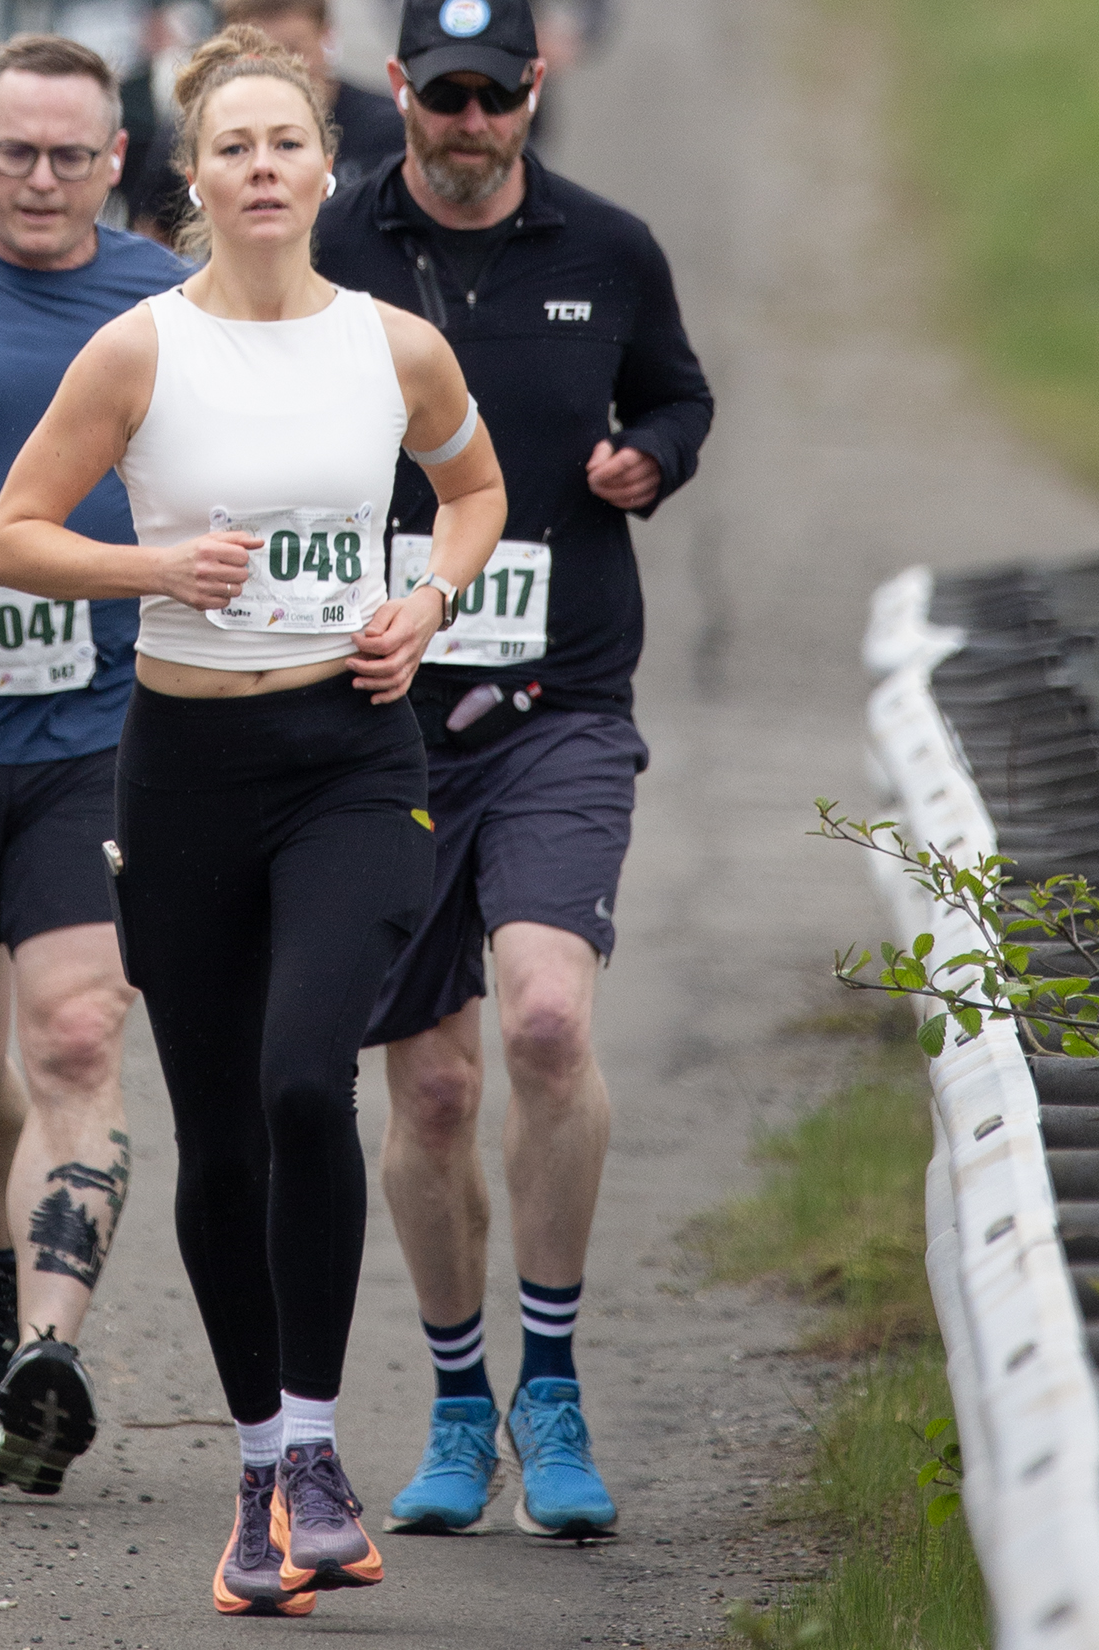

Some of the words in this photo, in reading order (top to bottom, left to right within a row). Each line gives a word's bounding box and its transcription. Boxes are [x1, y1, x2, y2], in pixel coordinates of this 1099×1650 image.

[268, 530, 362, 583] 048
[459, 568, 535, 617] 017
[322, 605, 345, 623] 048
[500, 642, 526, 656] 017
